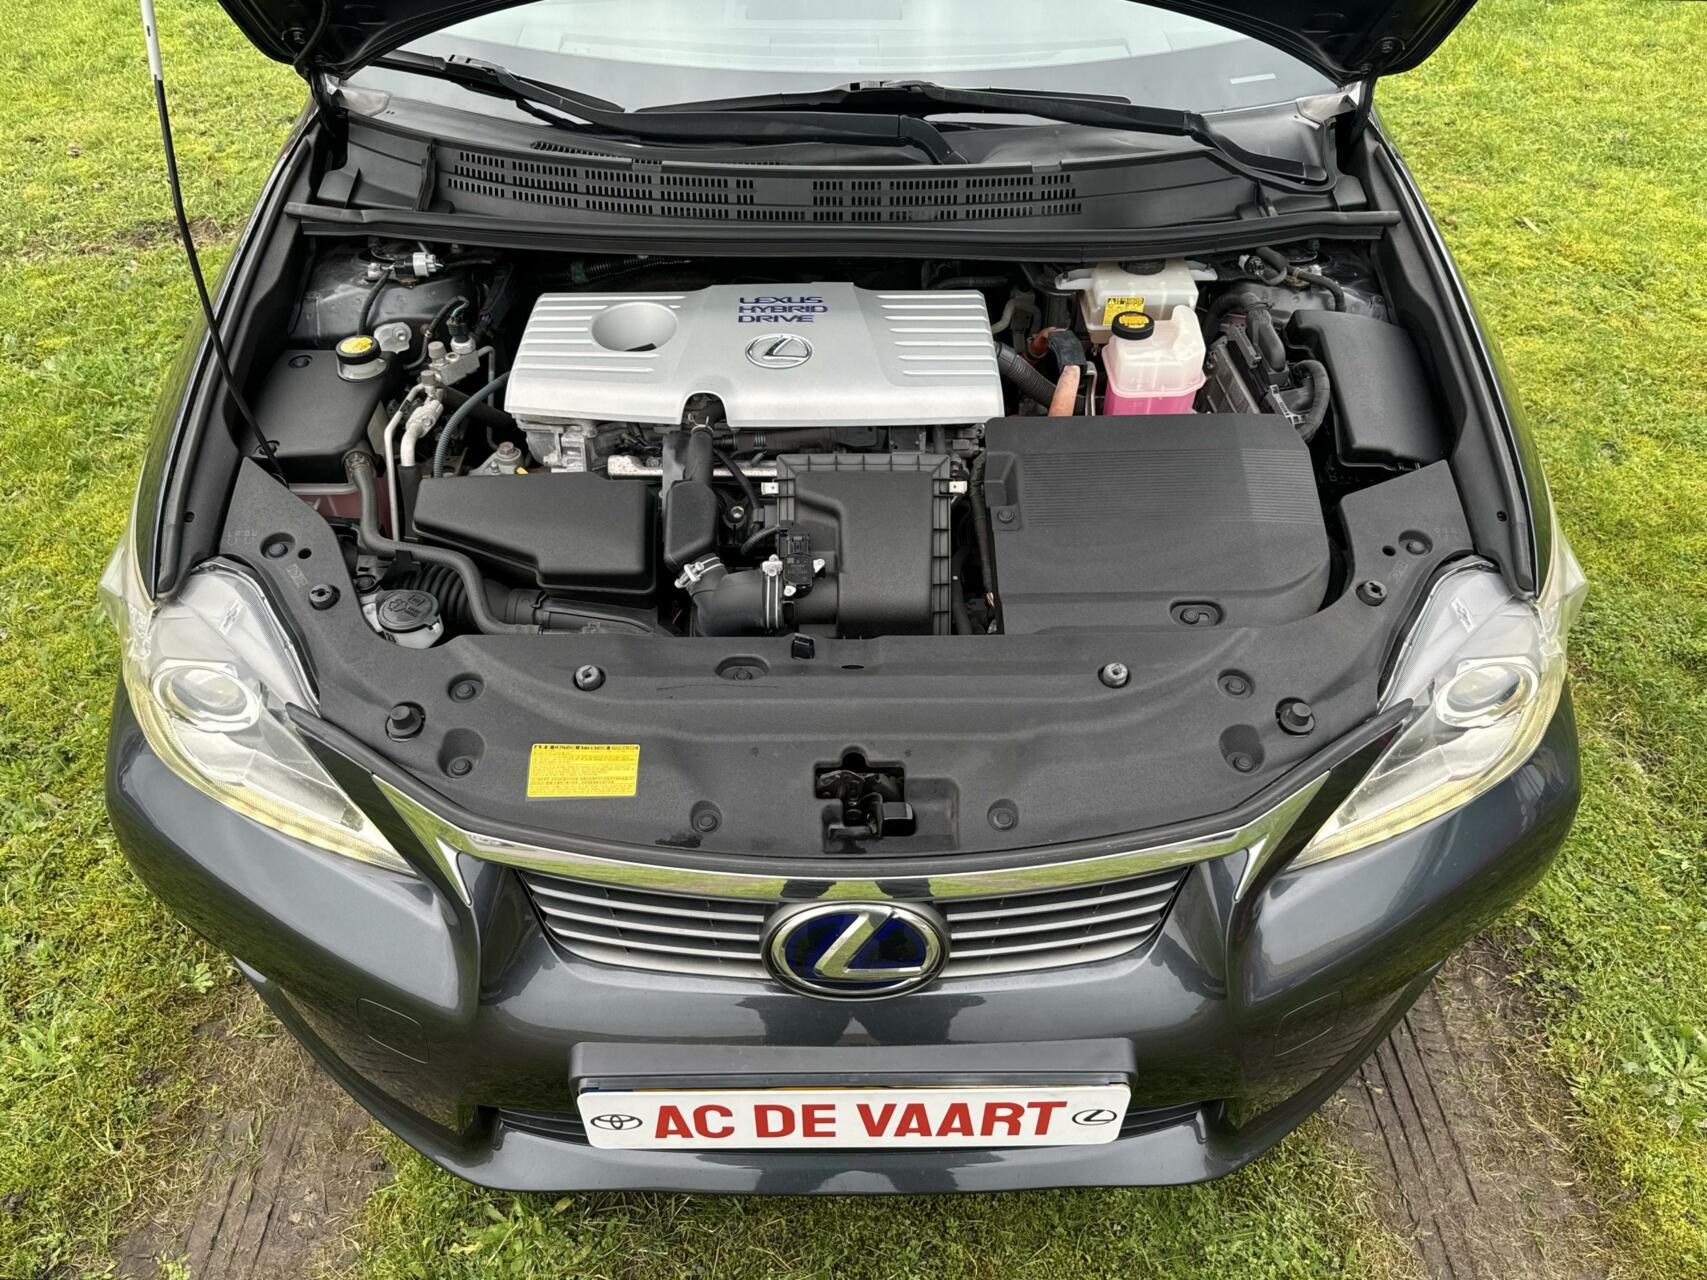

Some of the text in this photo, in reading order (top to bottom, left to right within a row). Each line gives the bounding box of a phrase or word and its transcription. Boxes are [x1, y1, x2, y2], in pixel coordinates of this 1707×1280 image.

[739, 296, 824, 304] LEXUS
[738, 305, 829, 314] HYBRID
[737, 314, 815, 323] DRIVE
[655, 1104, 734, 1140] AC
[753, 1103, 837, 1139] DE
[857, 1100, 1068, 1138] VAART
